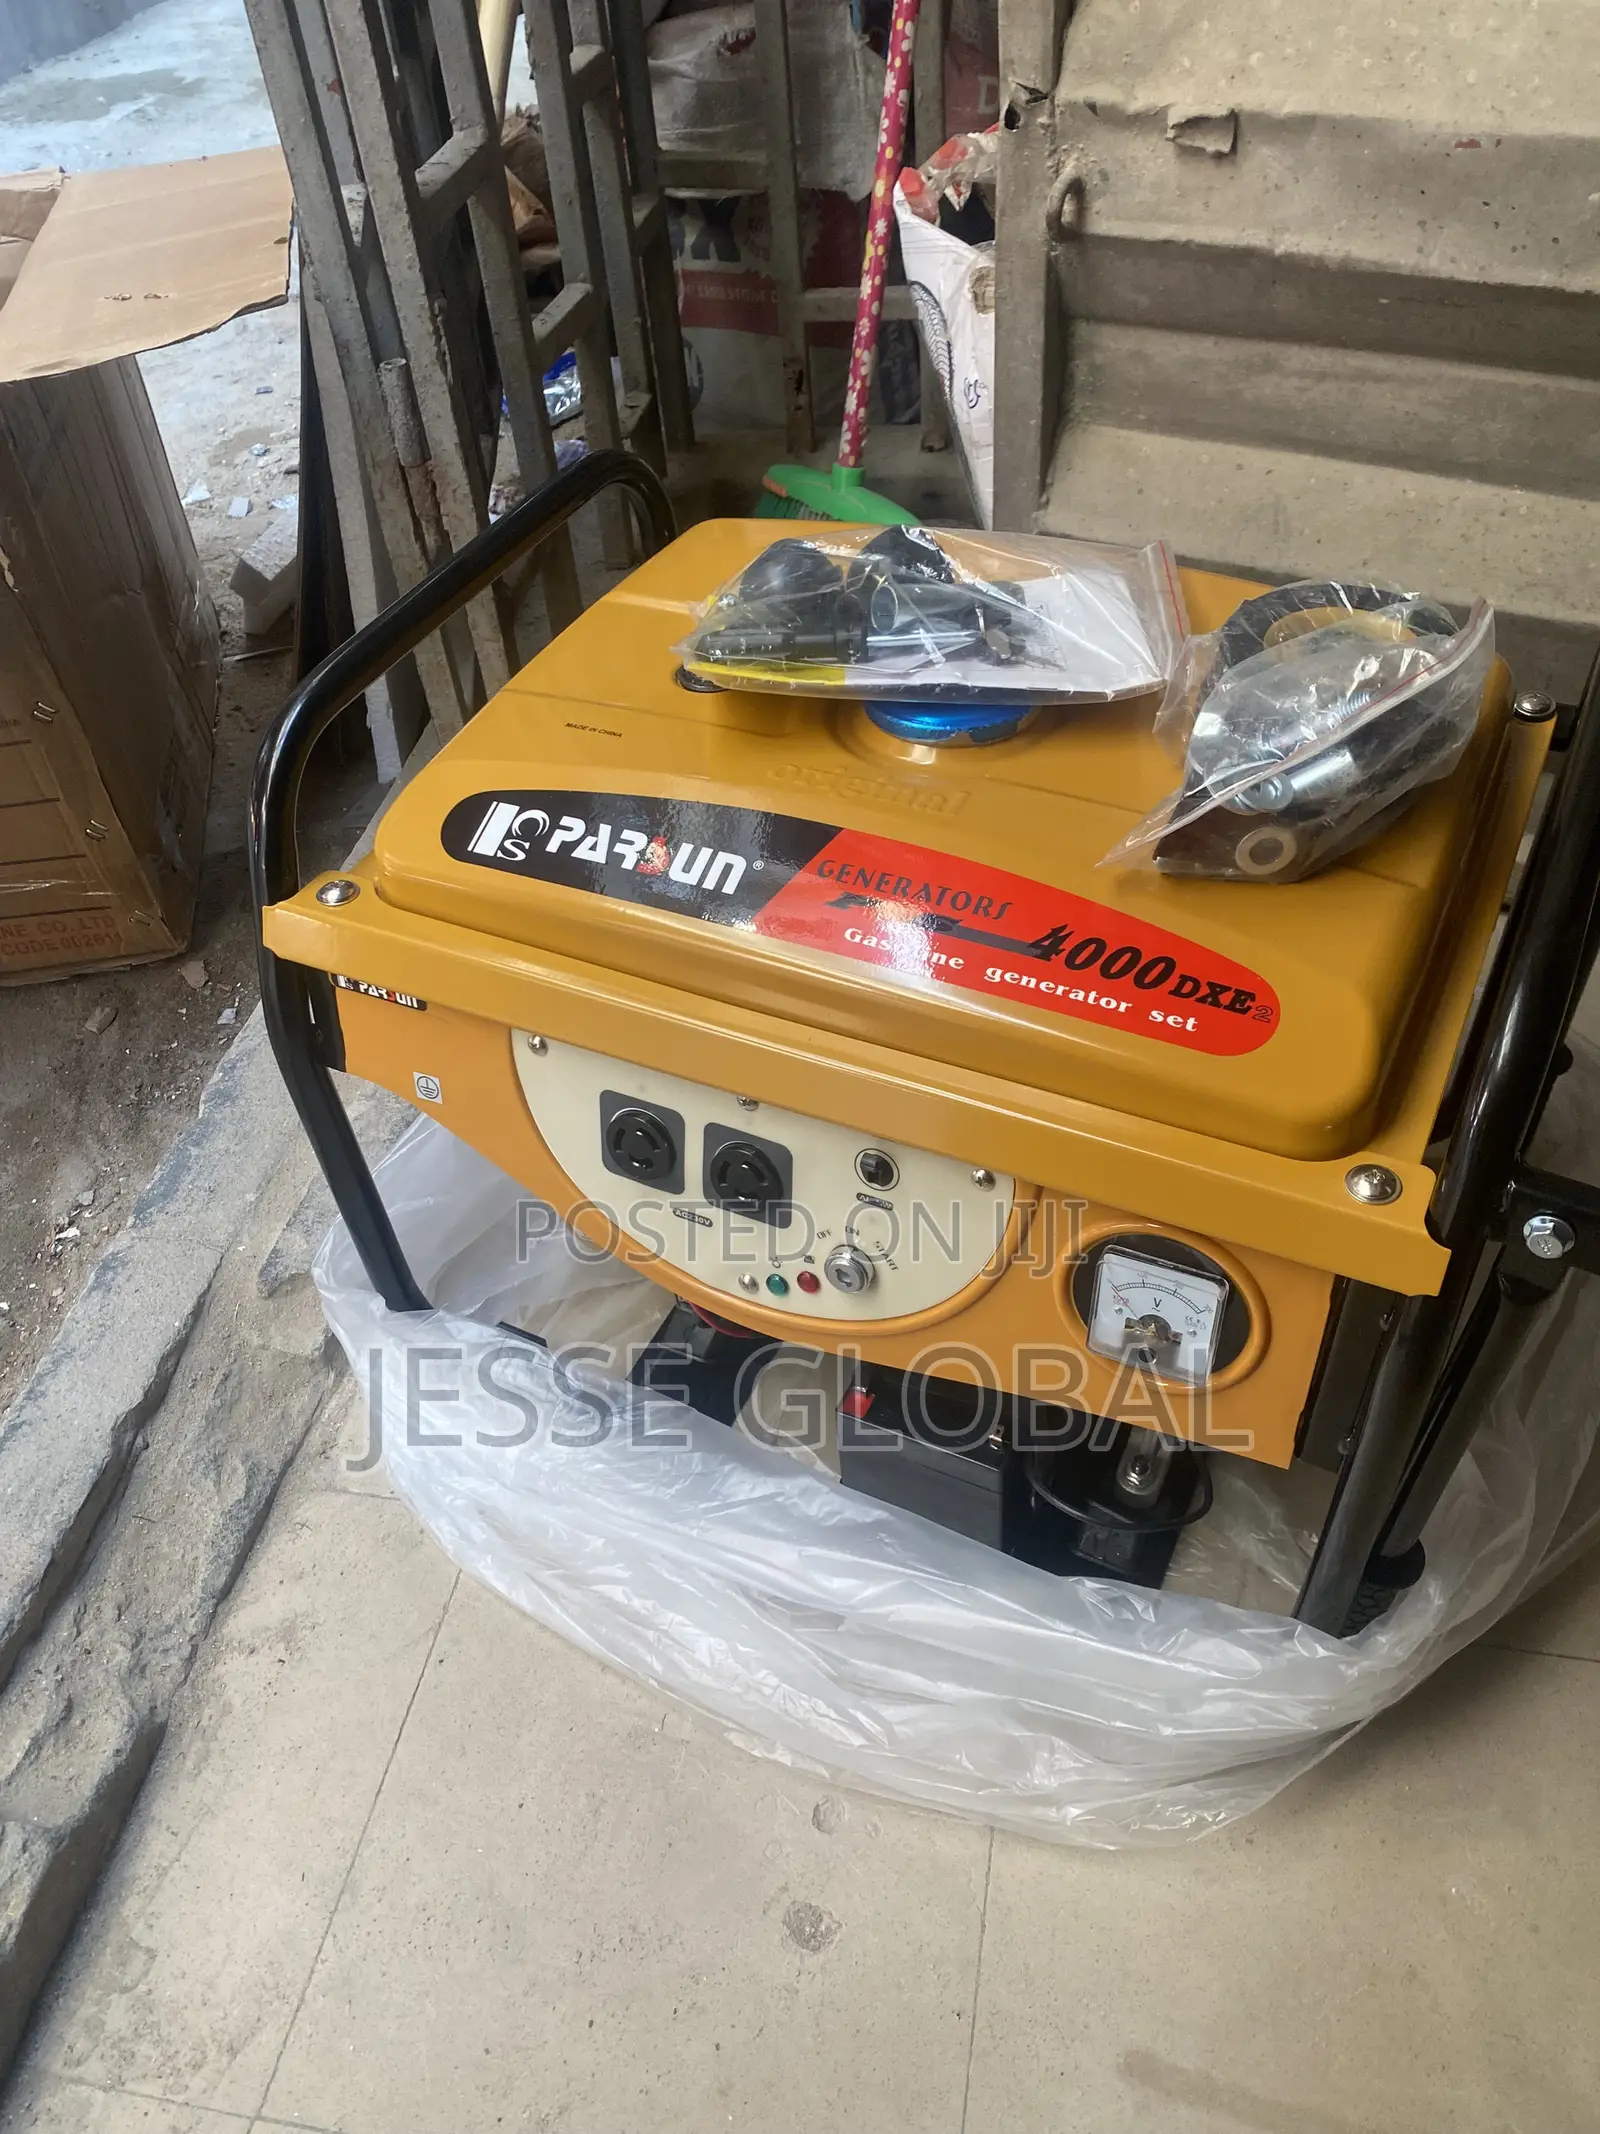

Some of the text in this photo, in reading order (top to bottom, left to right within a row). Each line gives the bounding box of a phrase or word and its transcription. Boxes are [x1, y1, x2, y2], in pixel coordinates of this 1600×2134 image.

[564, 722, 589, 731] MADE
[598, 728, 623, 738] CHINA
[817, 860, 1013, 920] GENERATORS
[984, 966, 1133, 1013] generator
[1148, 1009, 1197, 1032] set
[816, 1229, 833, 1240] OFF
[874, 1240, 900, 1272] START
